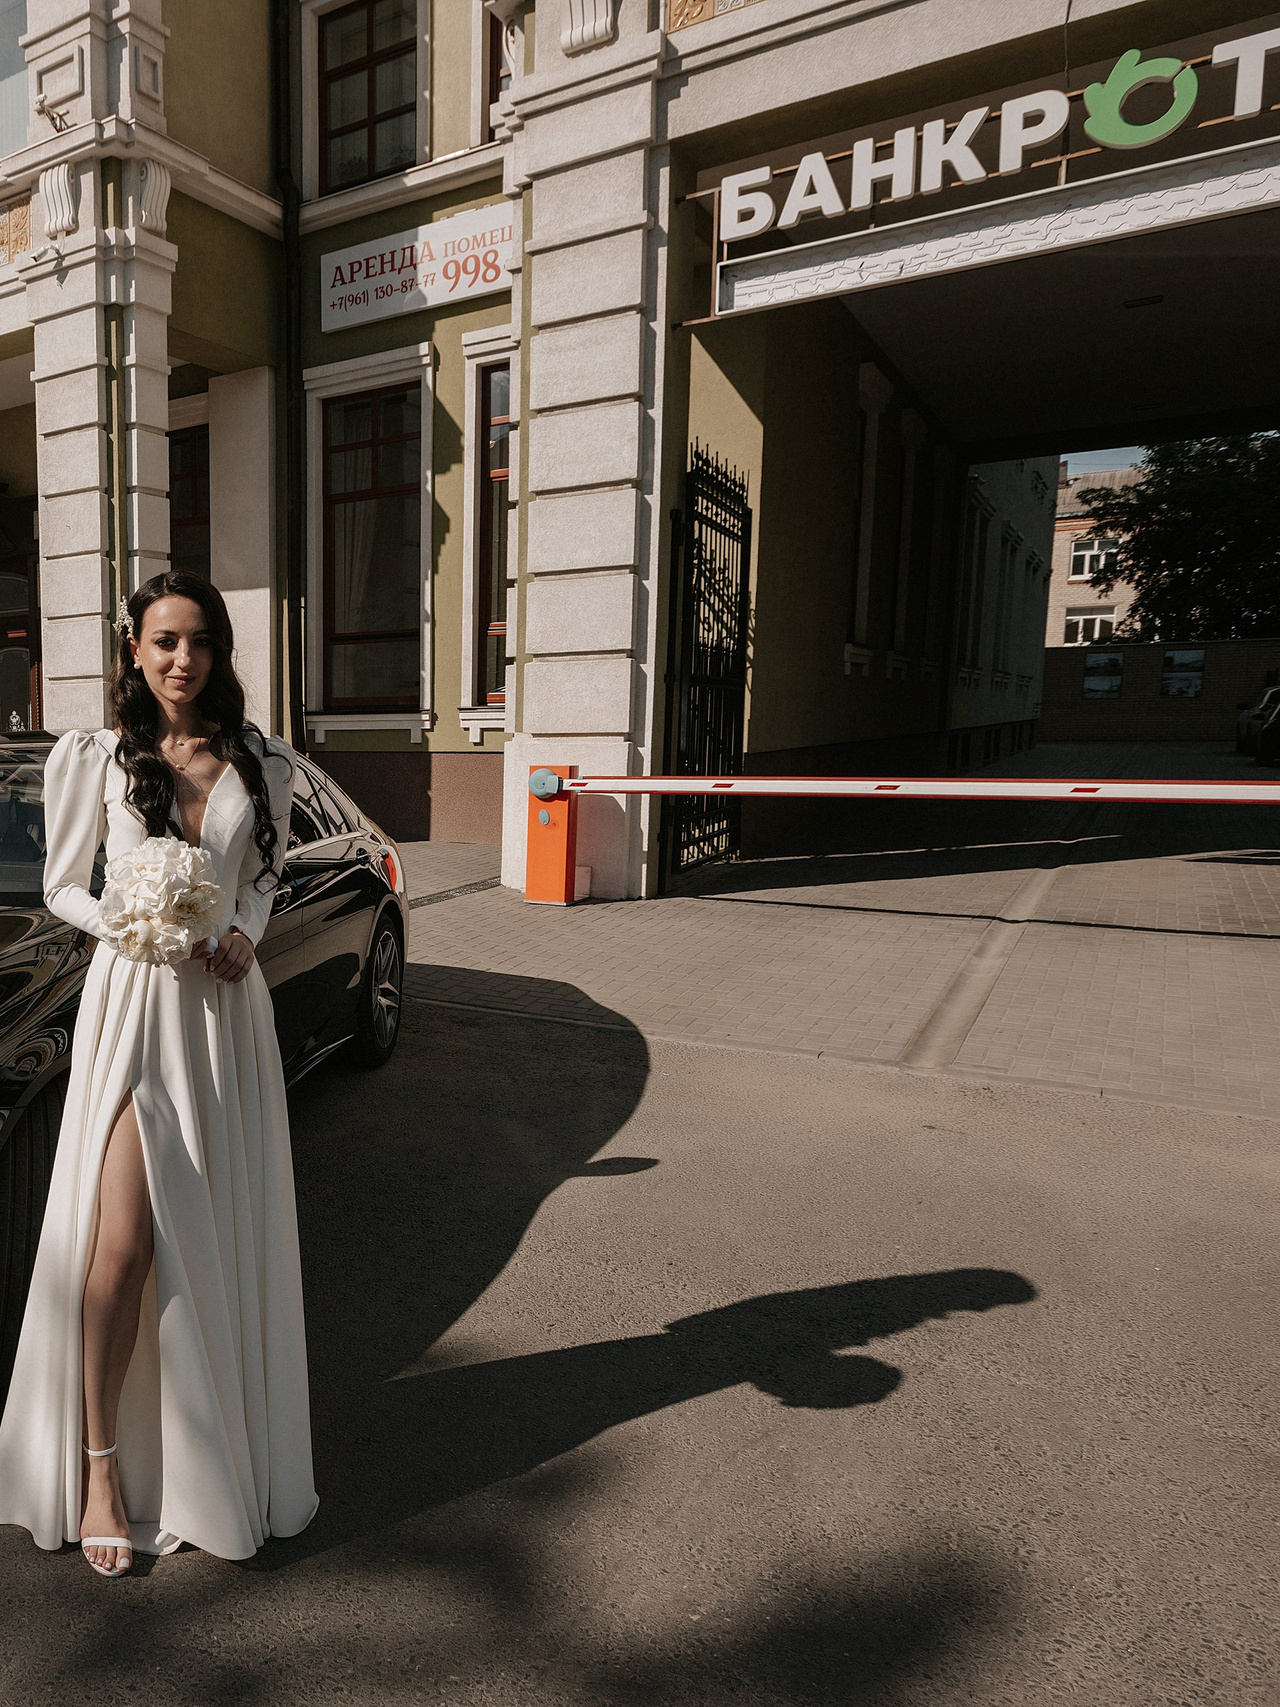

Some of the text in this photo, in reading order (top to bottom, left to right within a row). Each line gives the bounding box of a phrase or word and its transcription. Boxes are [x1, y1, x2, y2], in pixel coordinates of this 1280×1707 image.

[329, 241, 437, 289] АРЕНДА
[329, 272, 437, 312] +7(961) 130-87-77
